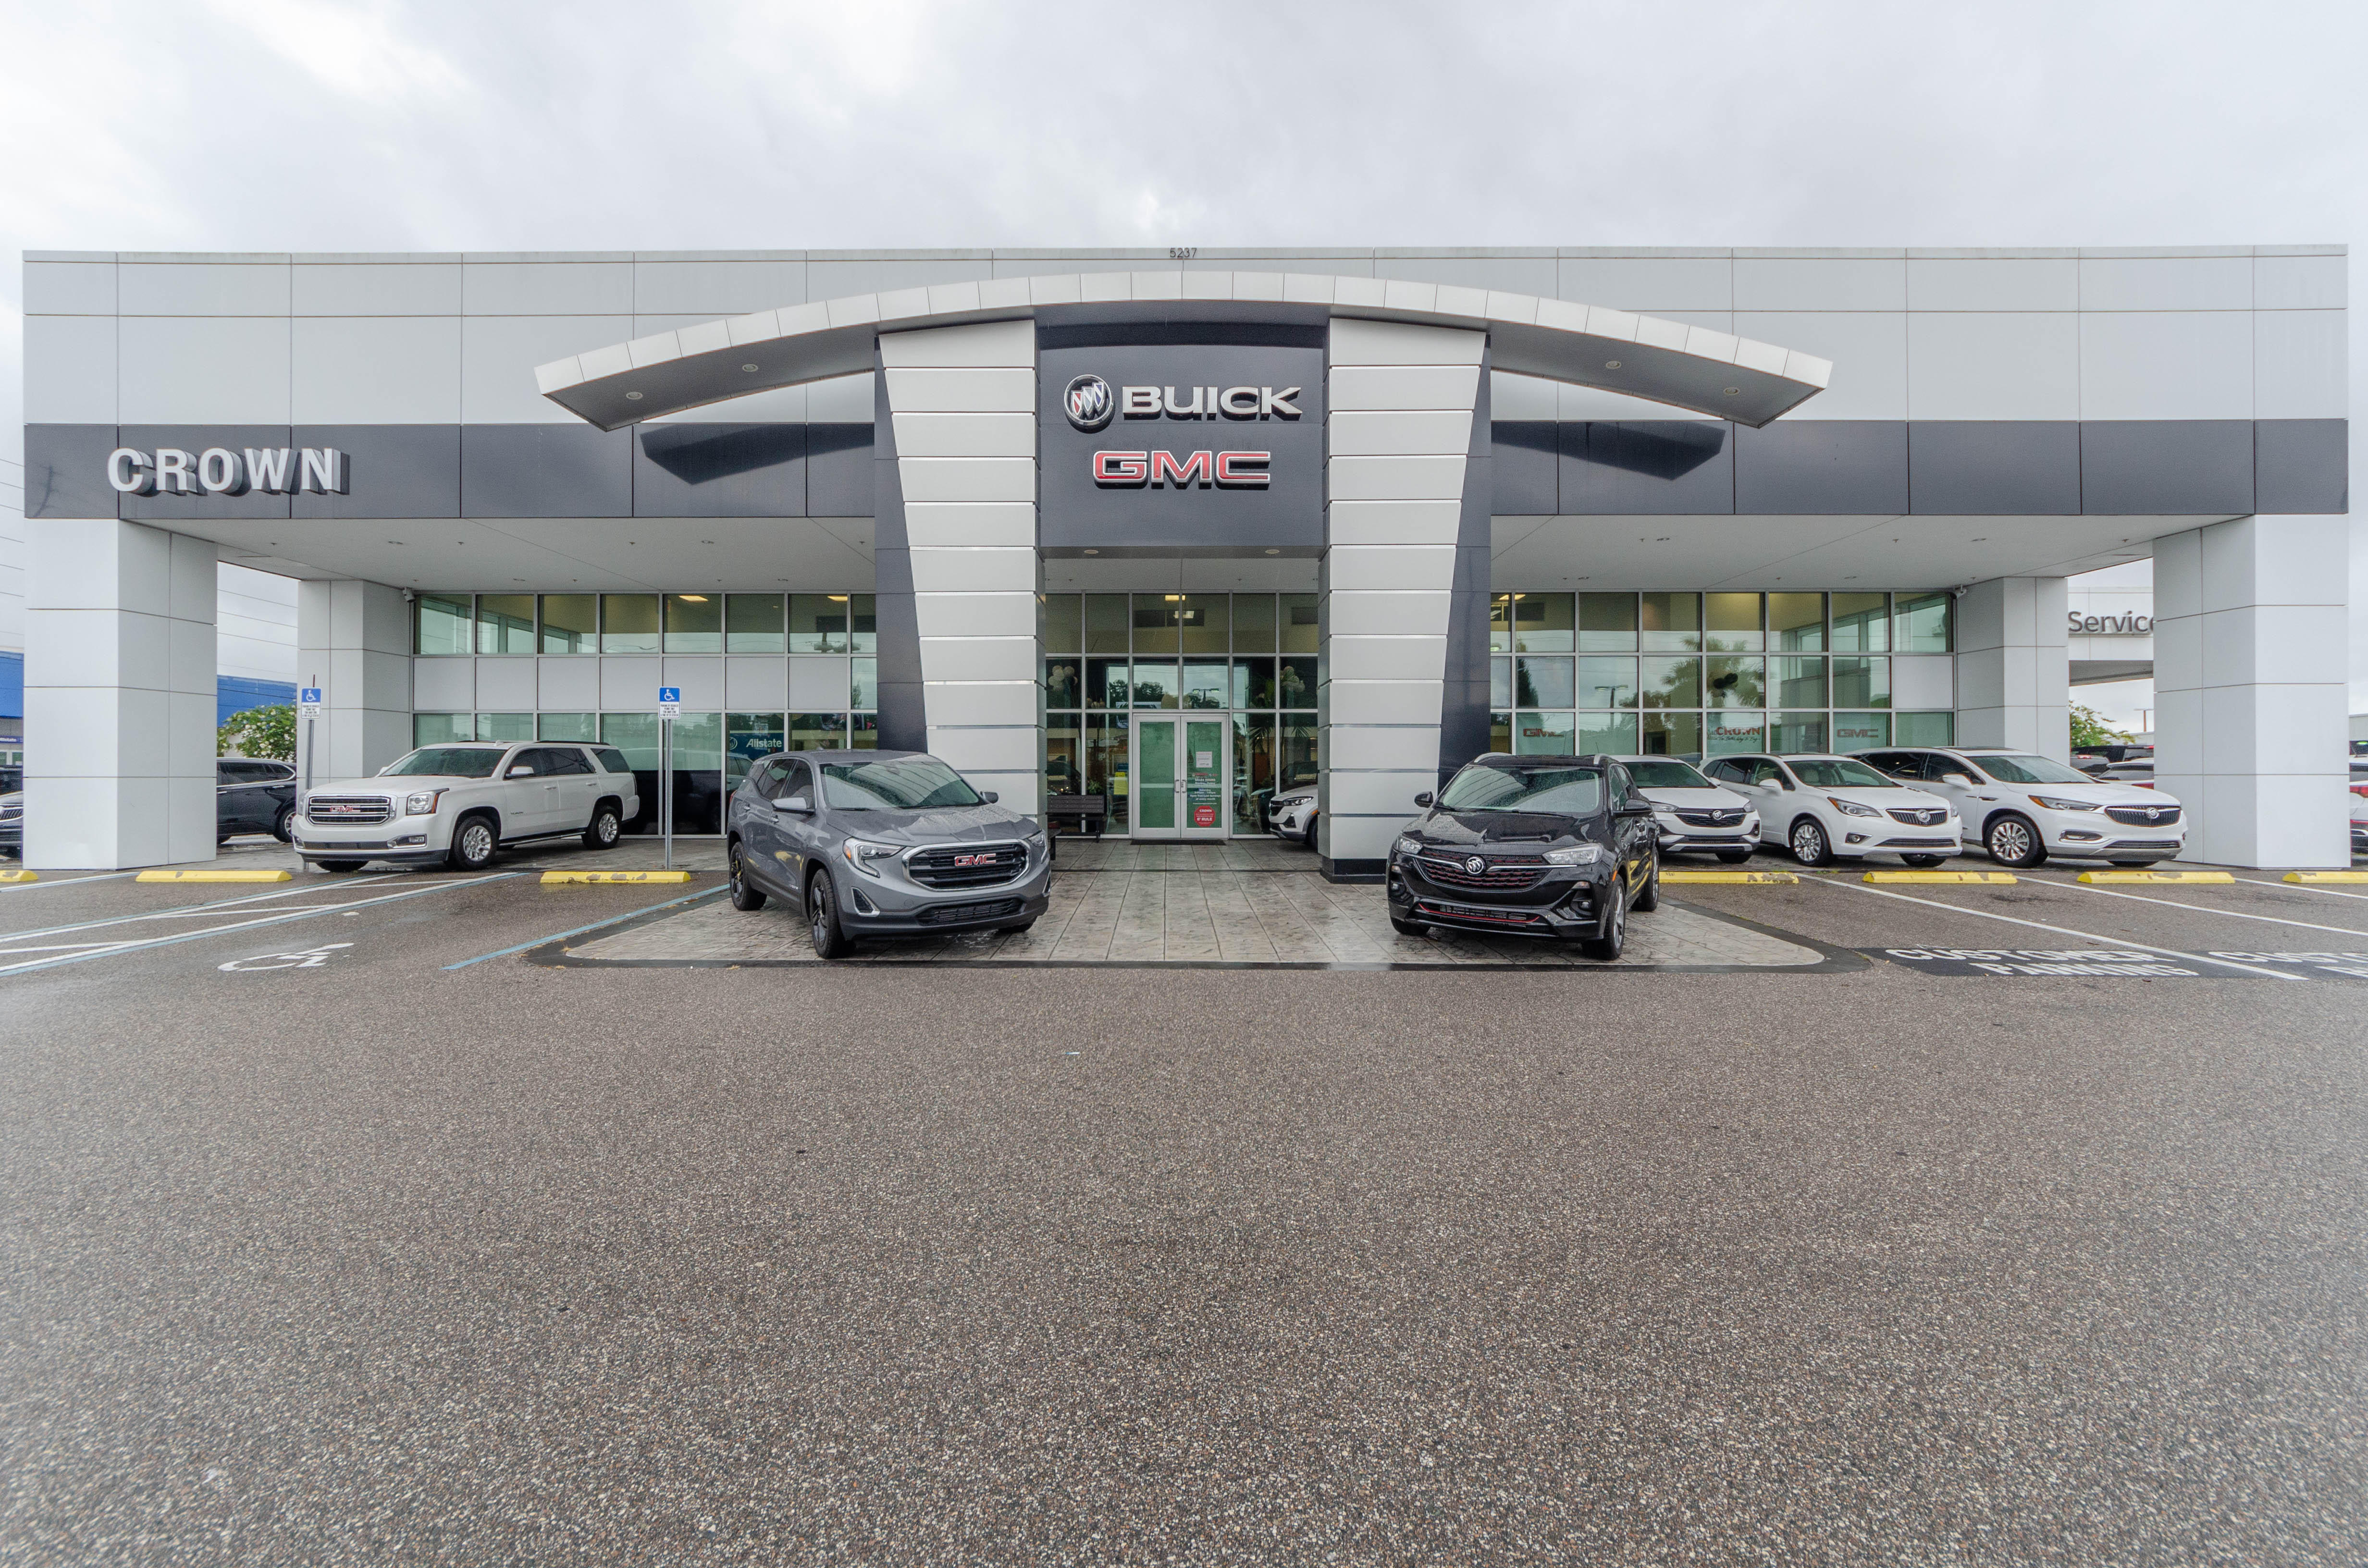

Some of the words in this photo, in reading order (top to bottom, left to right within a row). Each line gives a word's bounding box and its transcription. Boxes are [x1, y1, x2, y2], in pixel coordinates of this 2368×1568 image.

[1170, 247, 1197, 258] 5237
[1122, 386, 1303, 417] BUICK
[107, 447, 342, 493] CROWN
[1093, 450, 1271, 485] GMC
[1715, 726, 1760, 735] CROWN
[1837, 728, 1879, 738] GMC
[746, 738, 782, 747] Allstate
[954, 853, 996, 867] GMC
[1885, 949, 2178, 962] CUSTOMER
[1968, 963, 2199, 976] PARKING
